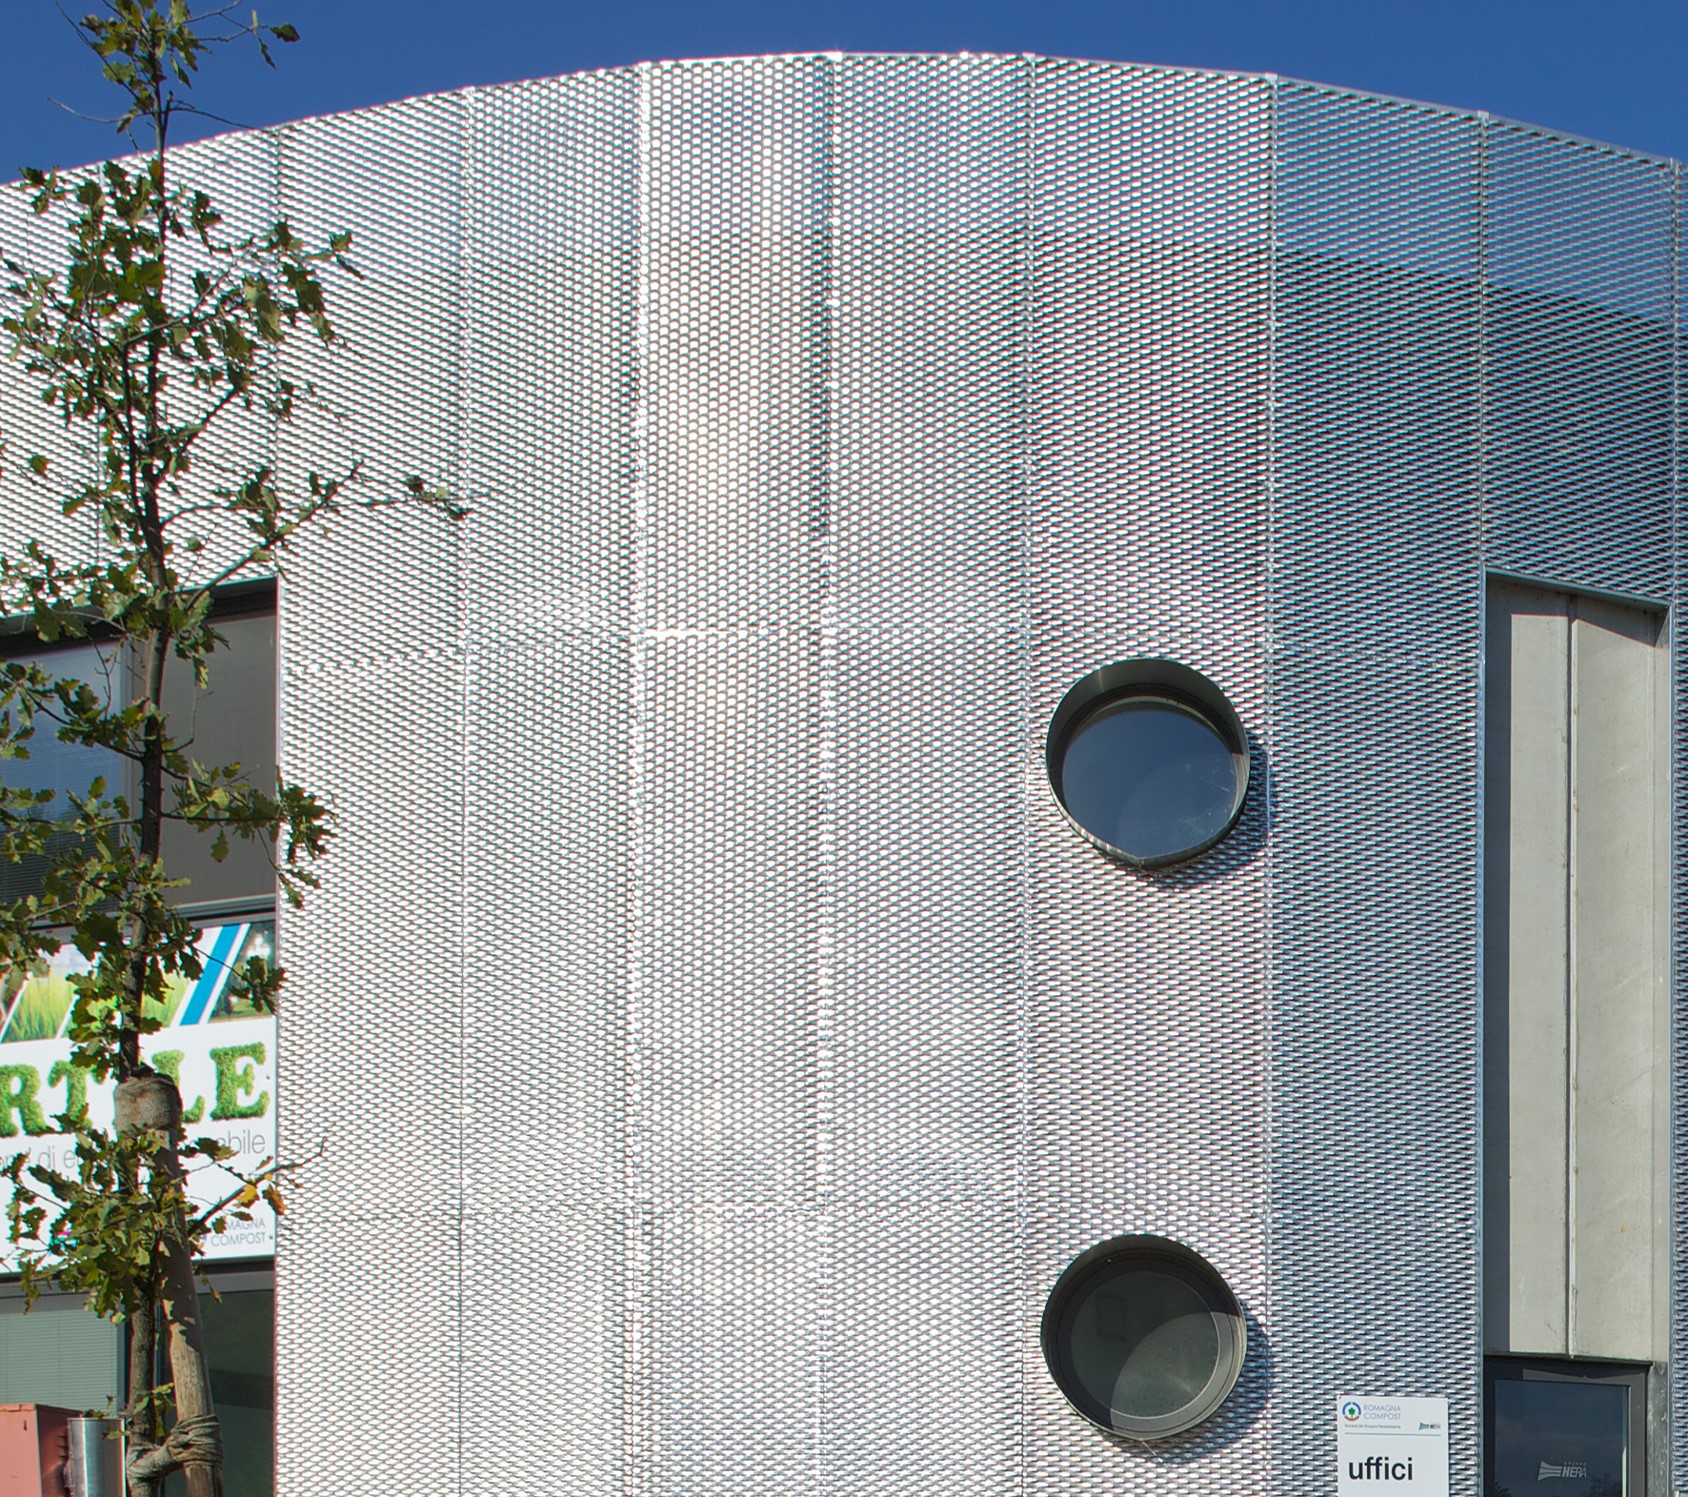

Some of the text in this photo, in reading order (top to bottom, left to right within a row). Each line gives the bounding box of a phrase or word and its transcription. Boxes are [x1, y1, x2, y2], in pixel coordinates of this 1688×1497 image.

[0, 1041, 270, 1138] RTLE
[210, 1231, 266, 1247] COMPOST
[1364, 1404, 1401, 1412] ROMAGNA
[1364, 1413, 1401, 1421] COMPOST
[1349, 1456, 1413, 1480] uffici
[1561, 1466, 1587, 1478] HERA
